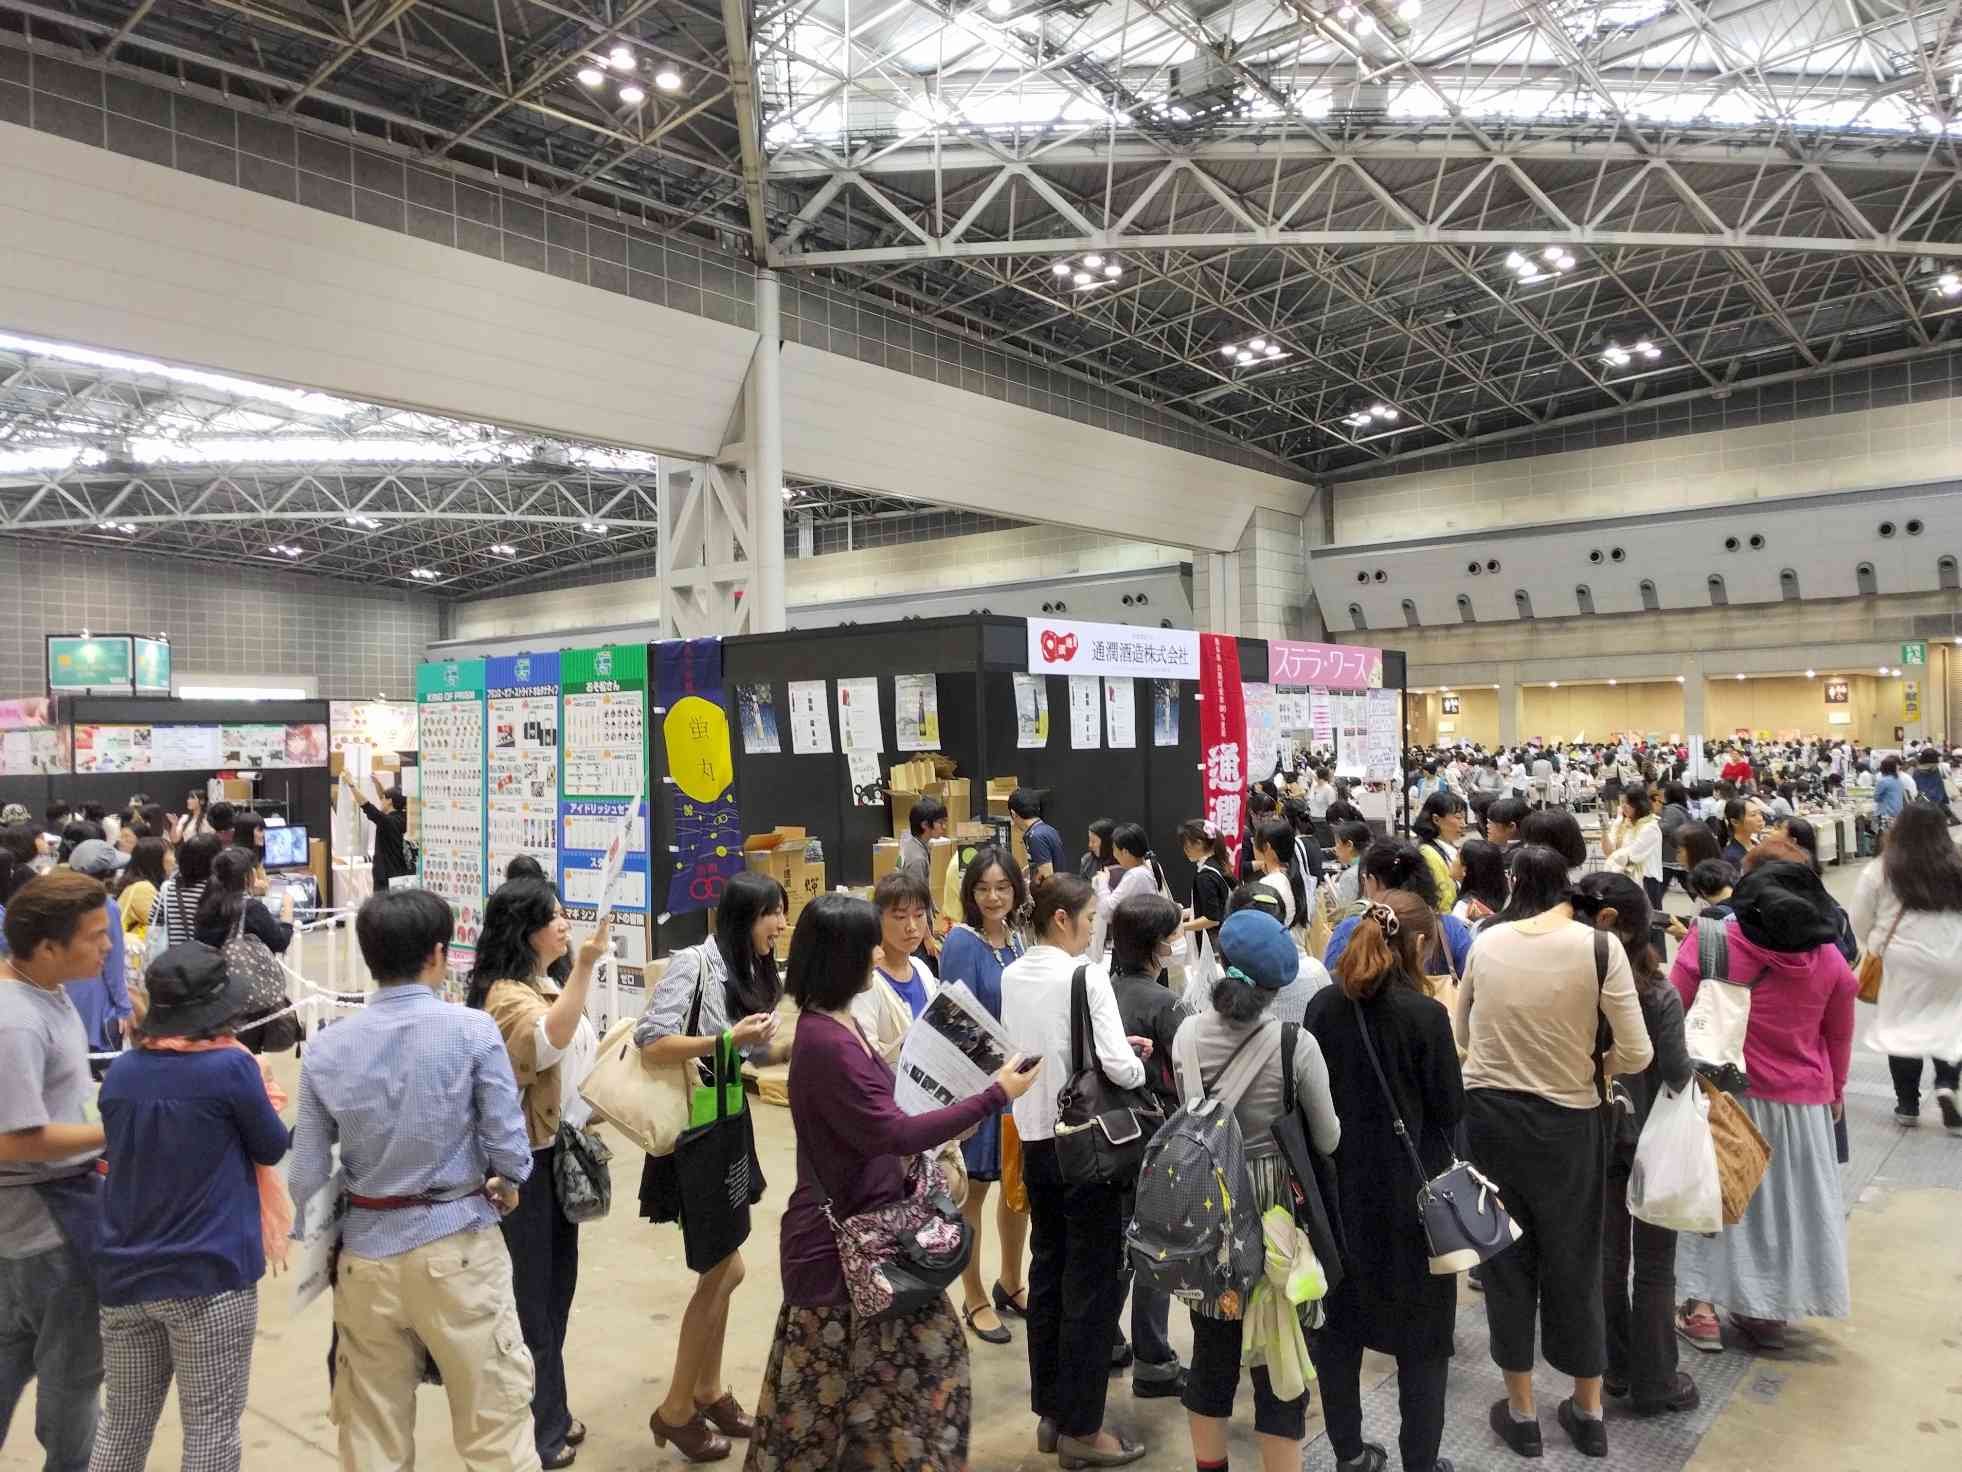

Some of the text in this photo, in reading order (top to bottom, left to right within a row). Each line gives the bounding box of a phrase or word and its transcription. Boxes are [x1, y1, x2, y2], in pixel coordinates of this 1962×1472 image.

[1091, 640, 1190, 665] 通潤酒造株式会社
[1273, 646, 1368, 681] ステラ・ワース
